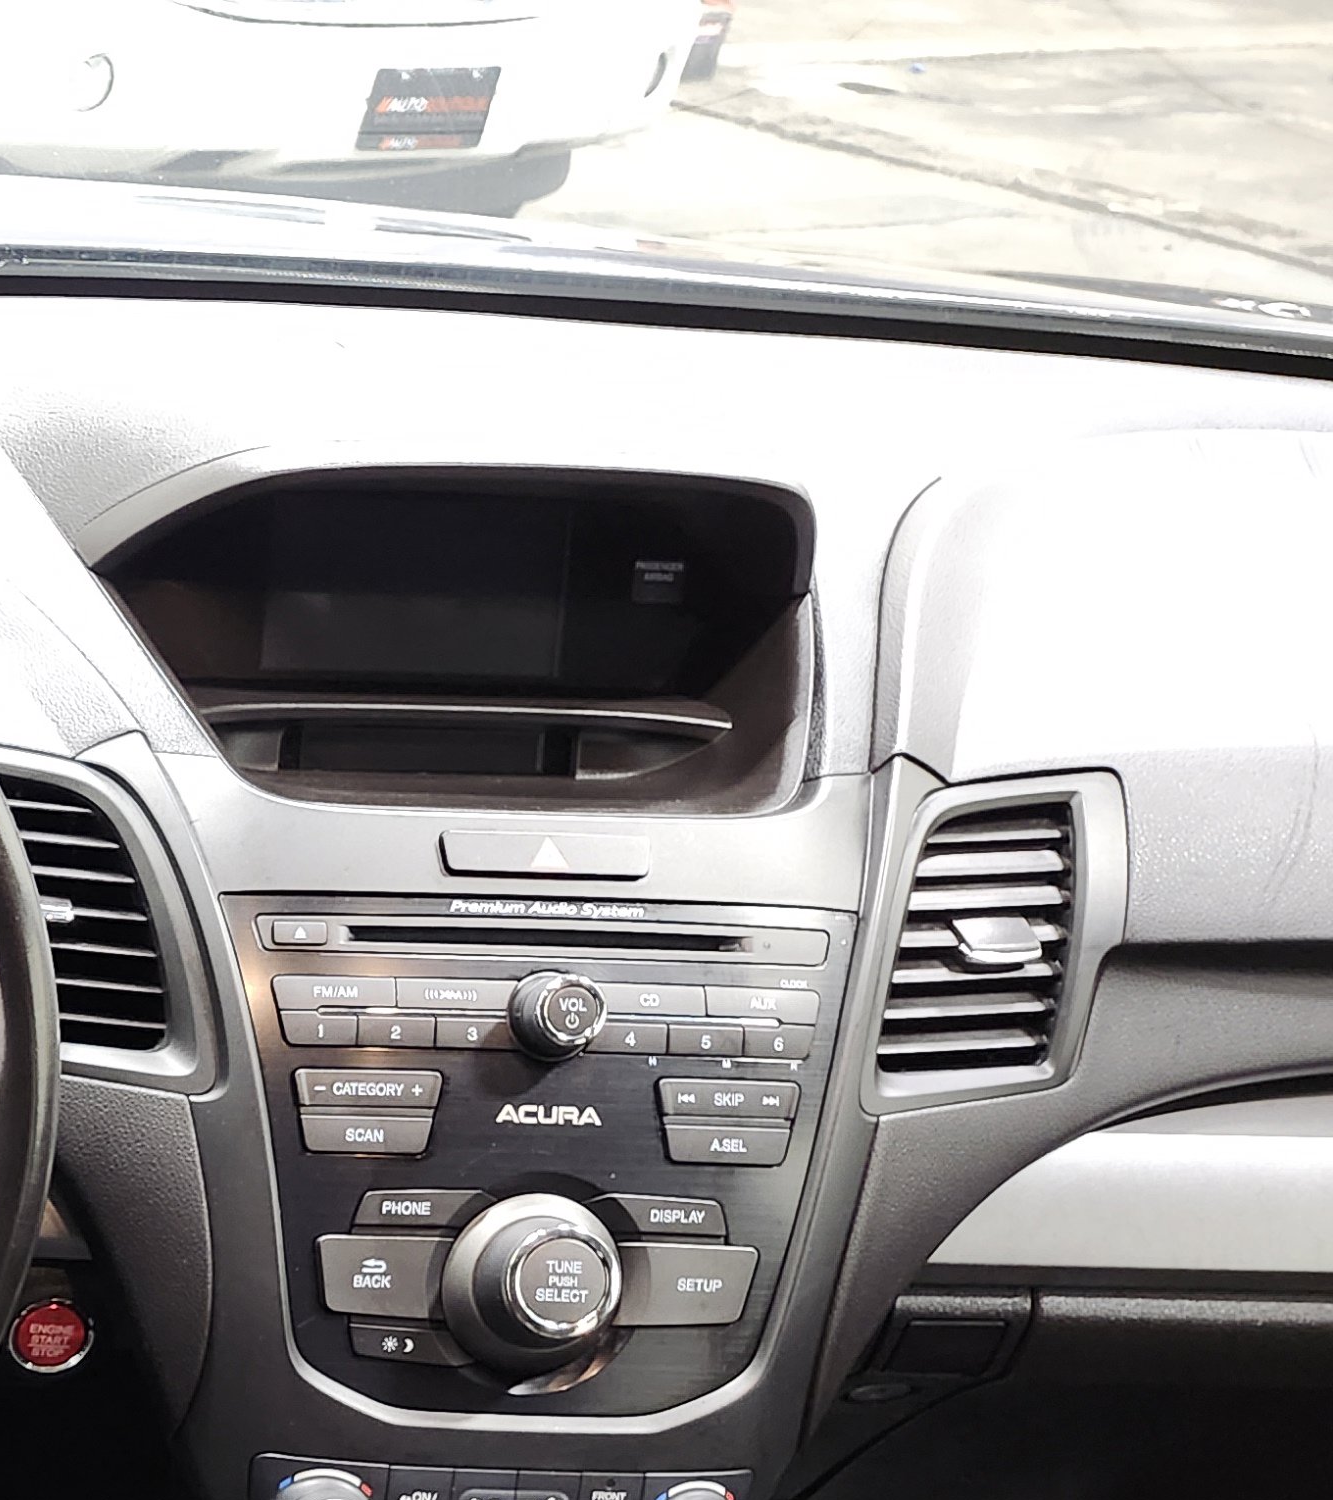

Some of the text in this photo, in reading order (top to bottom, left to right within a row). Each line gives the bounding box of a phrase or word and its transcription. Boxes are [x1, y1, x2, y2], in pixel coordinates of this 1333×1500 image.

[450, 899, 645, 919] Premium Audio System
[313, 986, 358, 998] FM/AM
[559, 997, 587, 1013] VOL
[639, 994, 660, 1007] CD
[750, 996, 777, 1011] AUX
[317, 1024, 324, 1039] 1
[390, 1025, 401, 1040] 2
[466, 1026, 478, 1041] 3
[624, 1032, 636, 1047] 4
[701, 1035, 712, 1050] 5
[773, 1037, 784, 1052] 6
[332, 1082, 404, 1096] CATEGORY
[713, 1092, 745, 1107] SKIP
[495, 1104, 602, 1126] ACURA
[345, 1128, 384, 1143] SCAN
[381, 1200, 432, 1217] PHONE
[649, 1207, 706, 1225] DISPLAY
[545, 1259, 583, 1275] TUNE
[352, 1272, 392, 1291] BACK
[548, 1275, 579, 1288] PUSH
[676, 1277, 723, 1293] SETUP
[534, 1287, 589, 1304] SELECT
[29, 1323, 74, 1336] ENGINE
[30, 1334, 69, 1345] START
[31, 1347, 65, 1358] STOP
